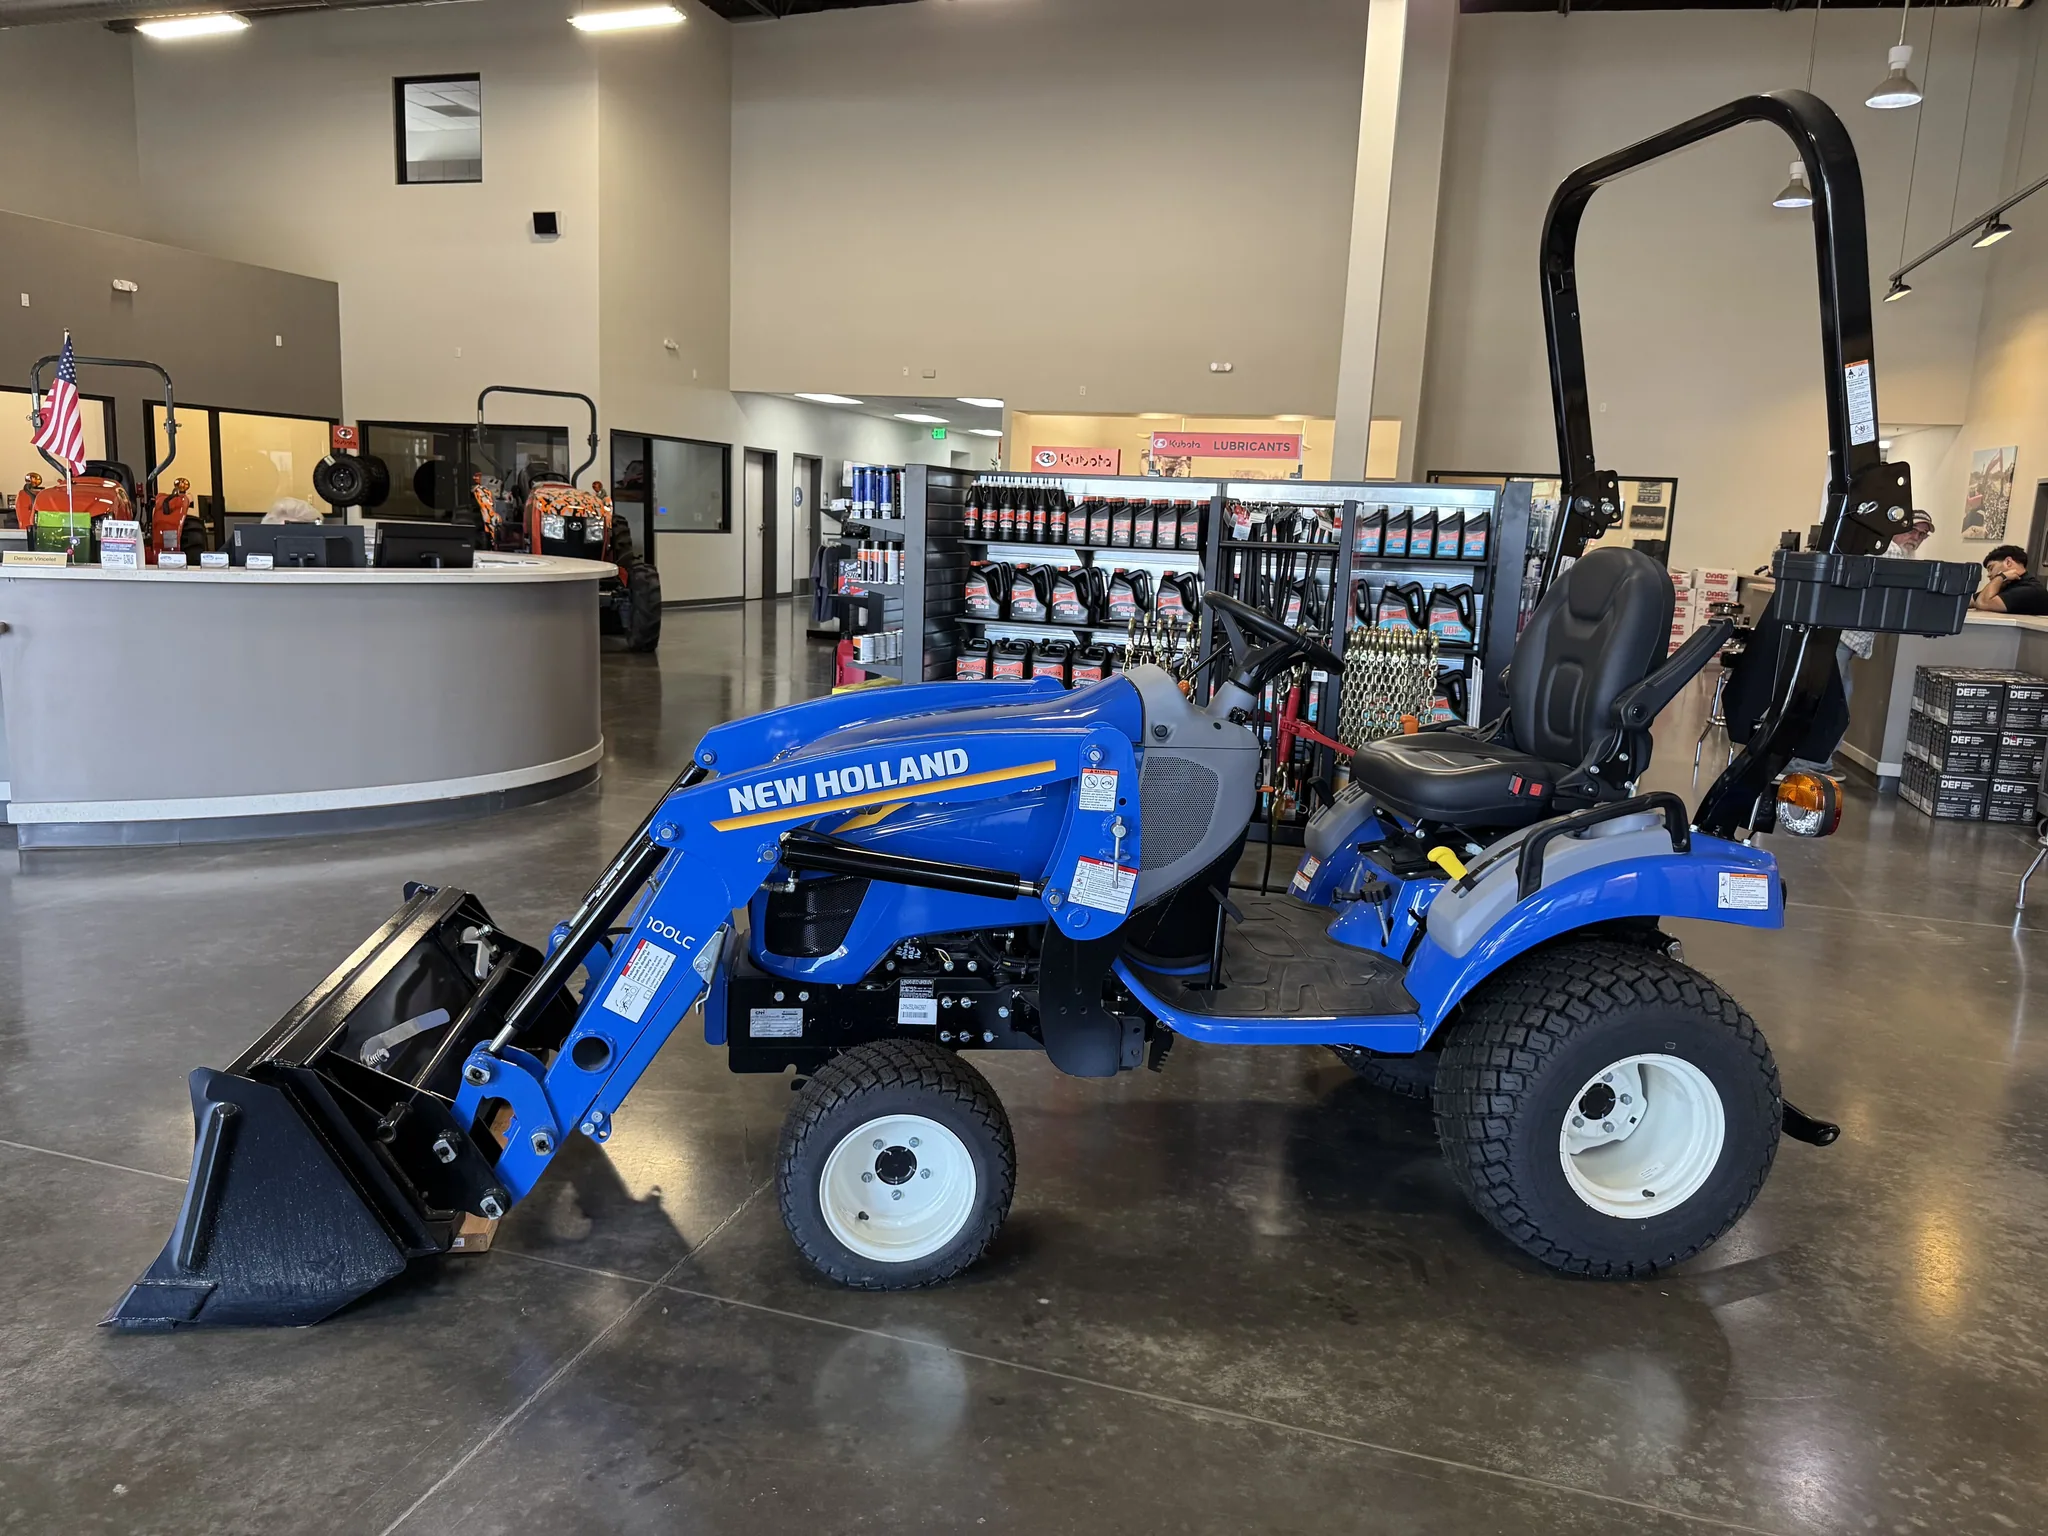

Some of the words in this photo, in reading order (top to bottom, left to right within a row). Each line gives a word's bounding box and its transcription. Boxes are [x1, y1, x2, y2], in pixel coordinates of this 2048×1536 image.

[1168, 440, 1201, 449] Kubota
[1213, 441, 1291, 452] LUBRICANTS
[1060, 453, 1112, 468] Kubota
[1956, 688, 1976, 696] DEF
[2010, 690, 2031, 699] DEF
[1951, 736, 1971, 744] DEF
[2002, 737, 2023, 746] DEF
[728, 775, 806, 814] NEW
[815, 748, 970, 798] HOLLAND
[1941, 780, 1961, 789] DEF
[1993, 784, 2014, 793] DEF
[646, 916, 696, 950] 100LC
